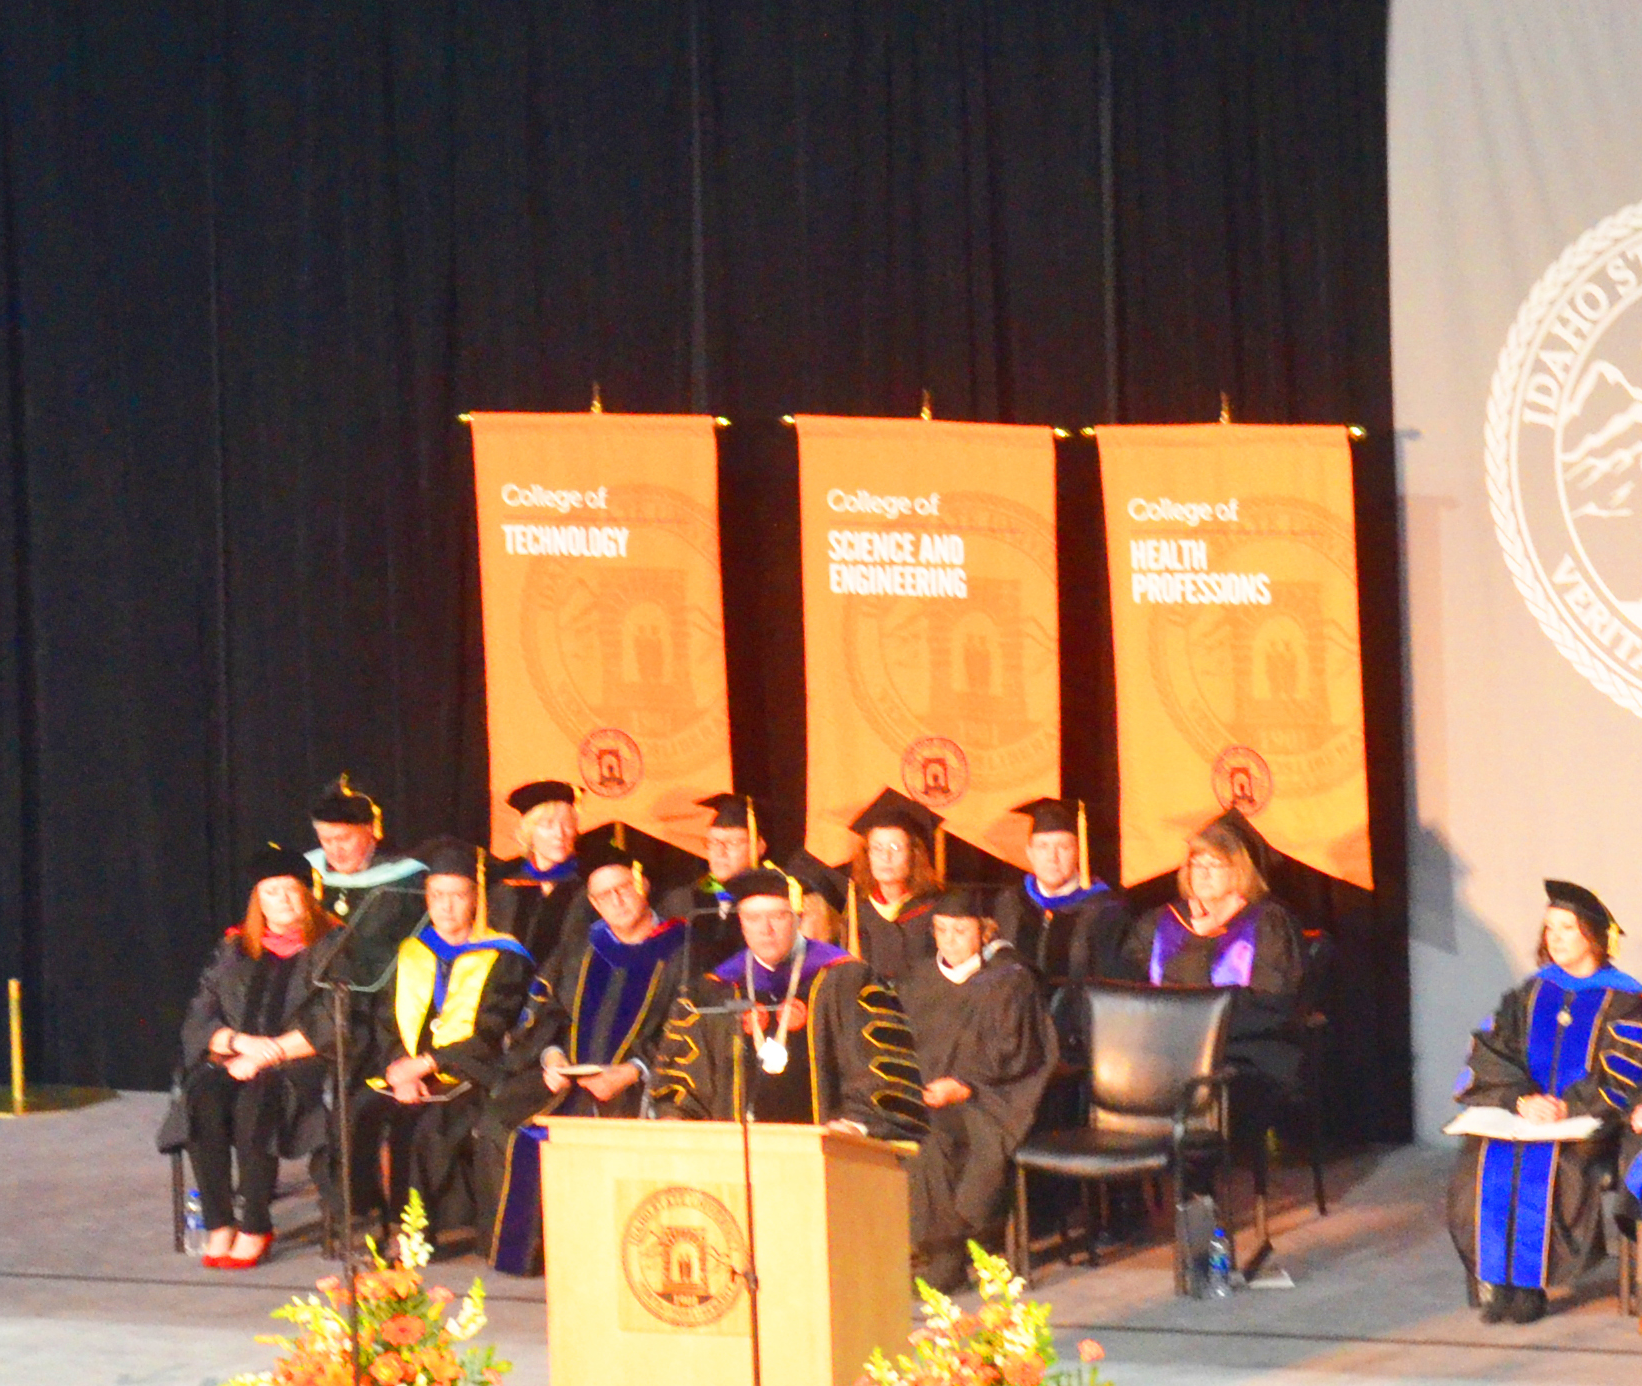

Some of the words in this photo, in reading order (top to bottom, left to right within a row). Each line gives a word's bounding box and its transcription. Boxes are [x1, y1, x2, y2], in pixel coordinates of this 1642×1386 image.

[1522, 282, 1610, 431] IDAHO
[501, 483, 583, 513] College
[584, 486, 608, 509] of
[827, 488, 912, 519] College
[914, 492, 941, 516] of
[1127, 497, 1213, 527] College
[1214, 498, 1239, 522] of
[501, 524, 629, 558] TECHNOLOGY
[827, 530, 916, 563] SCIENCE
[919, 533, 965, 566] AND
[1129, 539, 1208, 571] HEALTH
[829, 563, 968, 599] ENGINEERING
[1131, 572, 1272, 606] PROFESSIONS
